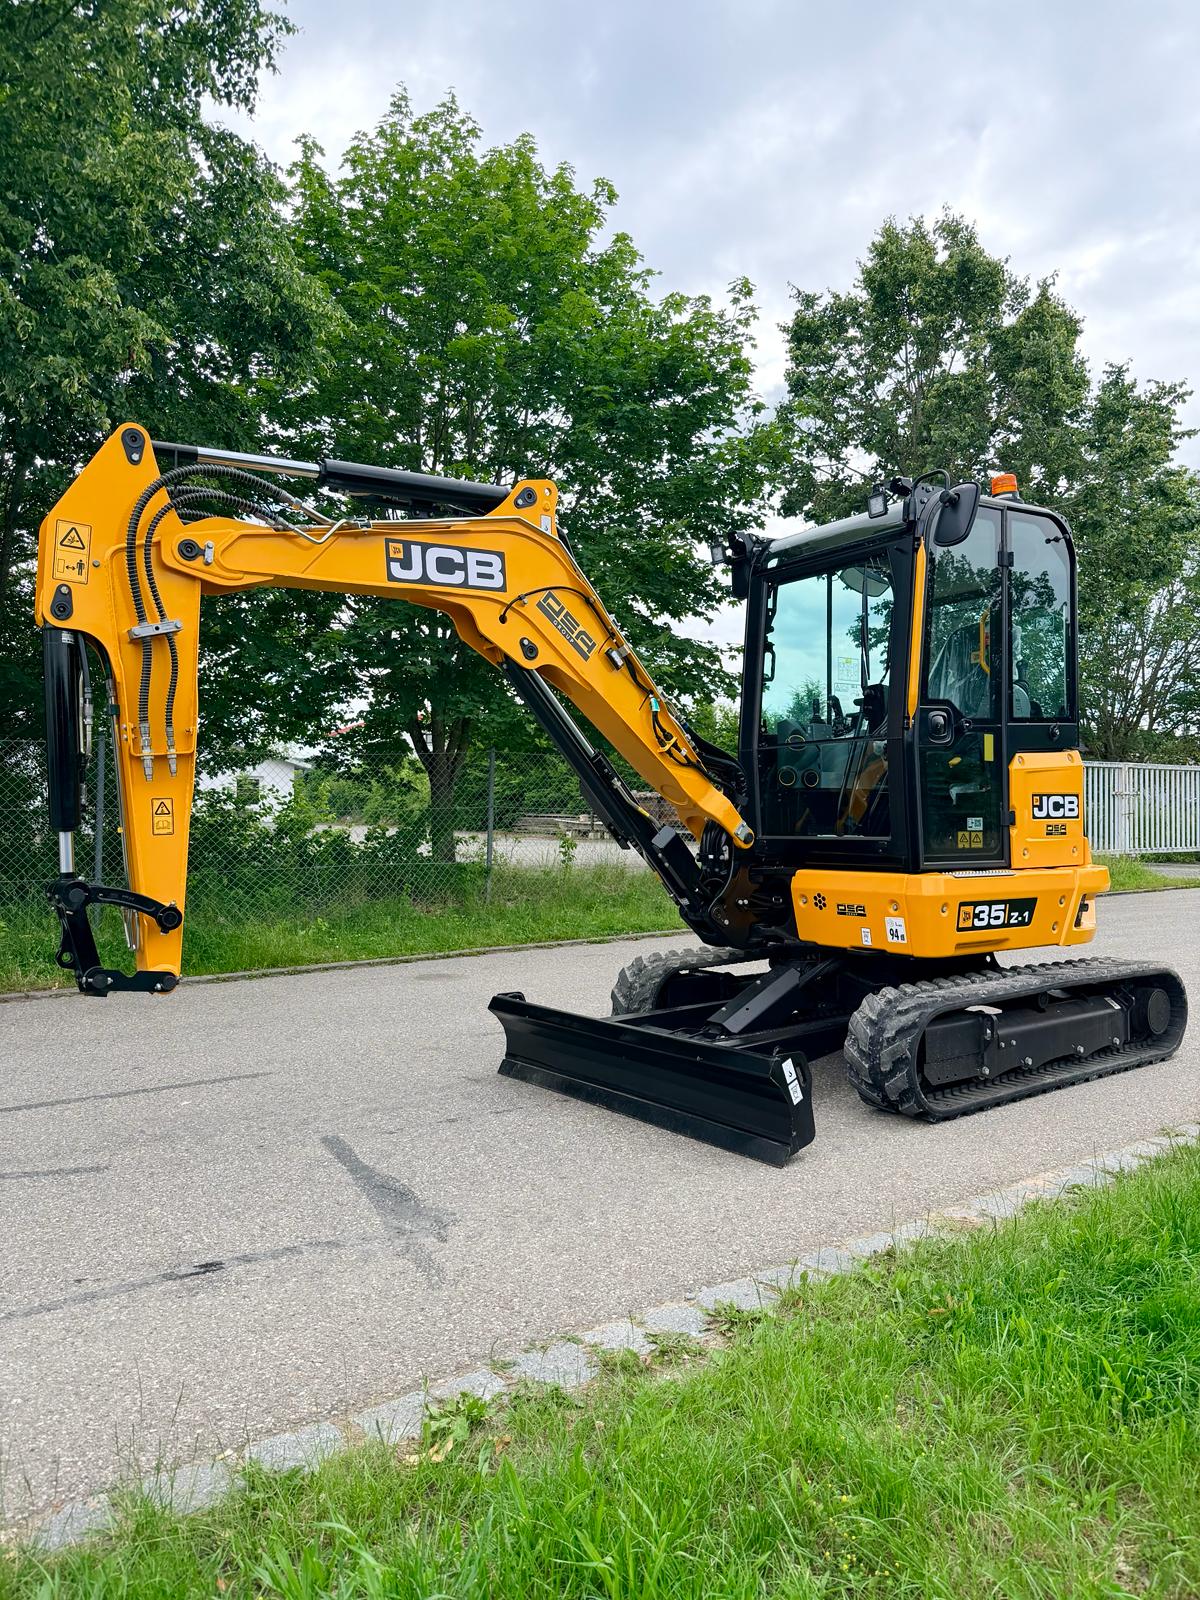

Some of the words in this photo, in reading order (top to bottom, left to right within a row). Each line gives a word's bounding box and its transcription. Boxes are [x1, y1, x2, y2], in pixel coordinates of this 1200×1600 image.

[390, 544, 504, 588] JCB
[540, 590, 597, 654] DSA
[552, 619, 575, 643] GROUP
[1033, 795, 1079, 817] JCB
[836, 903, 866, 913] DSA
[973, 904, 1006, 927] 35
[1009, 911, 1030, 924] Z-1
[889, 928, 900, 941] 94
